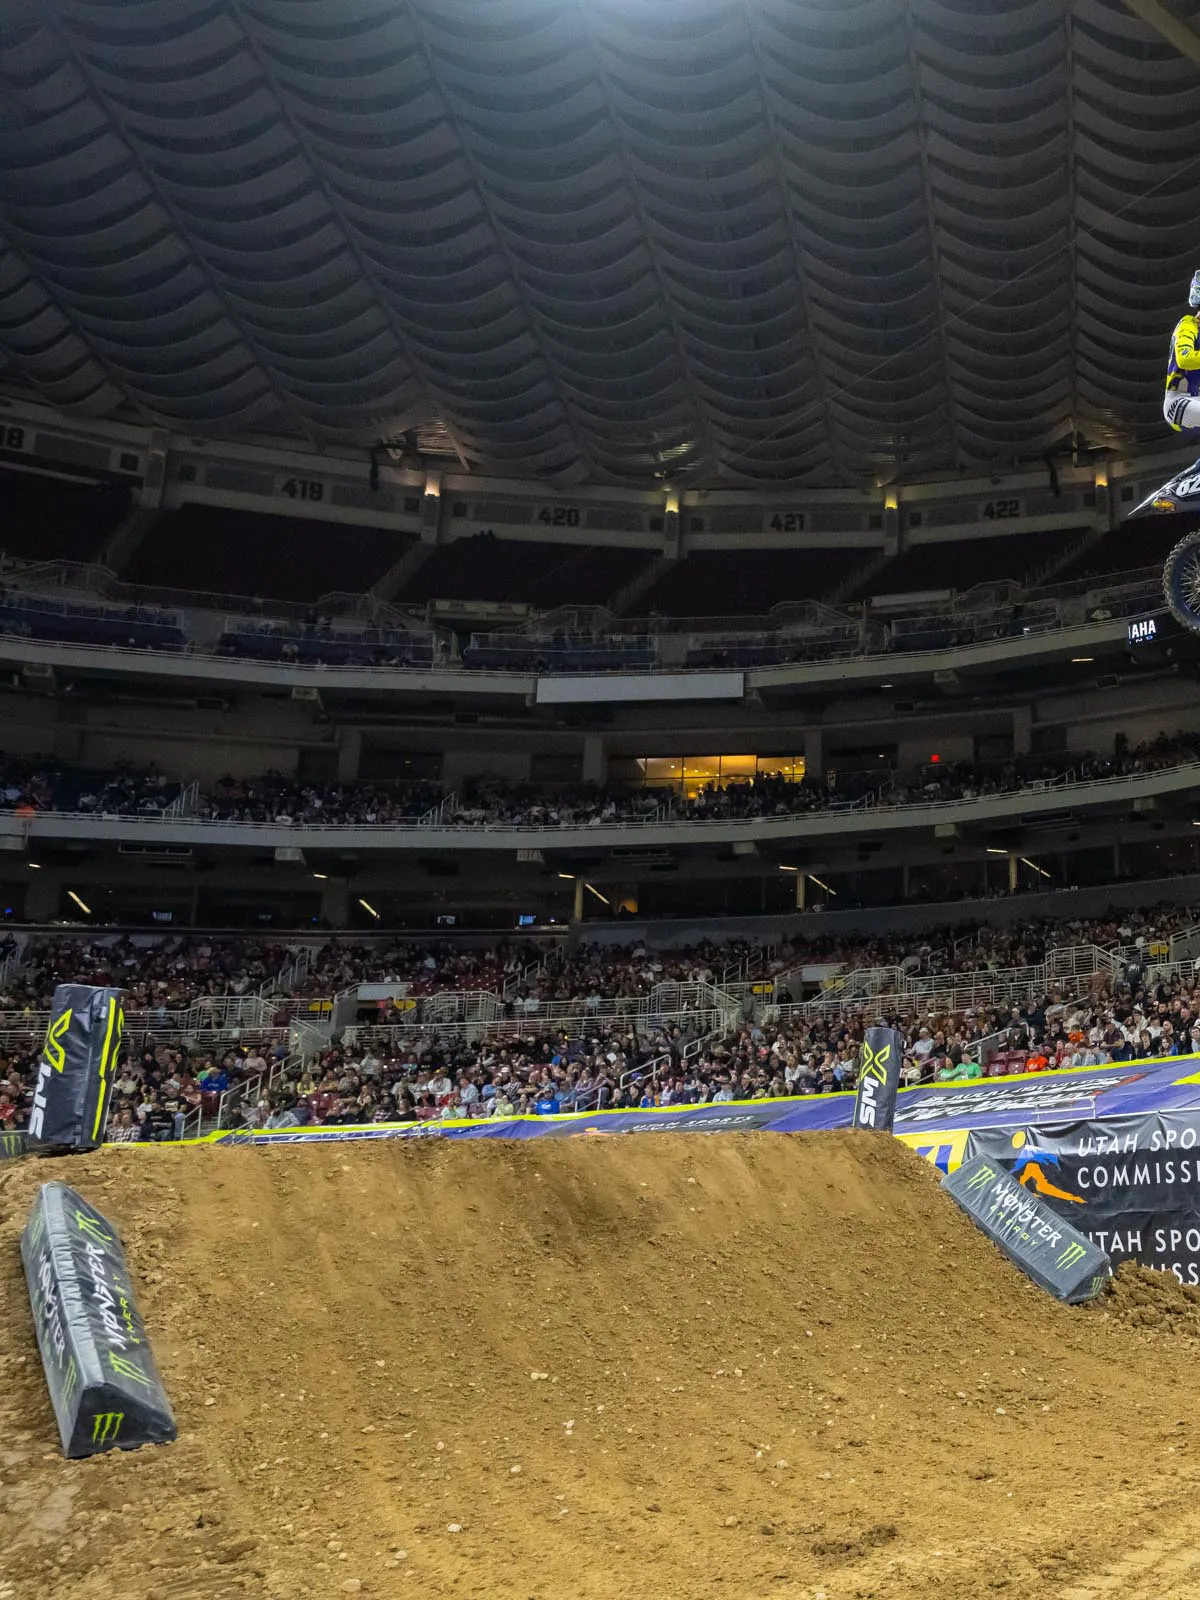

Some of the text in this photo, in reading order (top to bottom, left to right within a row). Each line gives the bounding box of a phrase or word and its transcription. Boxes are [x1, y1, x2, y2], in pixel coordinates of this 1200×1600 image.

[539, 506, 580, 528] 420
[983, 499, 1019, 520] 422
[769, 513, 805, 532] 421
[1077, 1133, 1139, 1158] UTAH
[991, 1182, 1063, 1249] MONSTER
